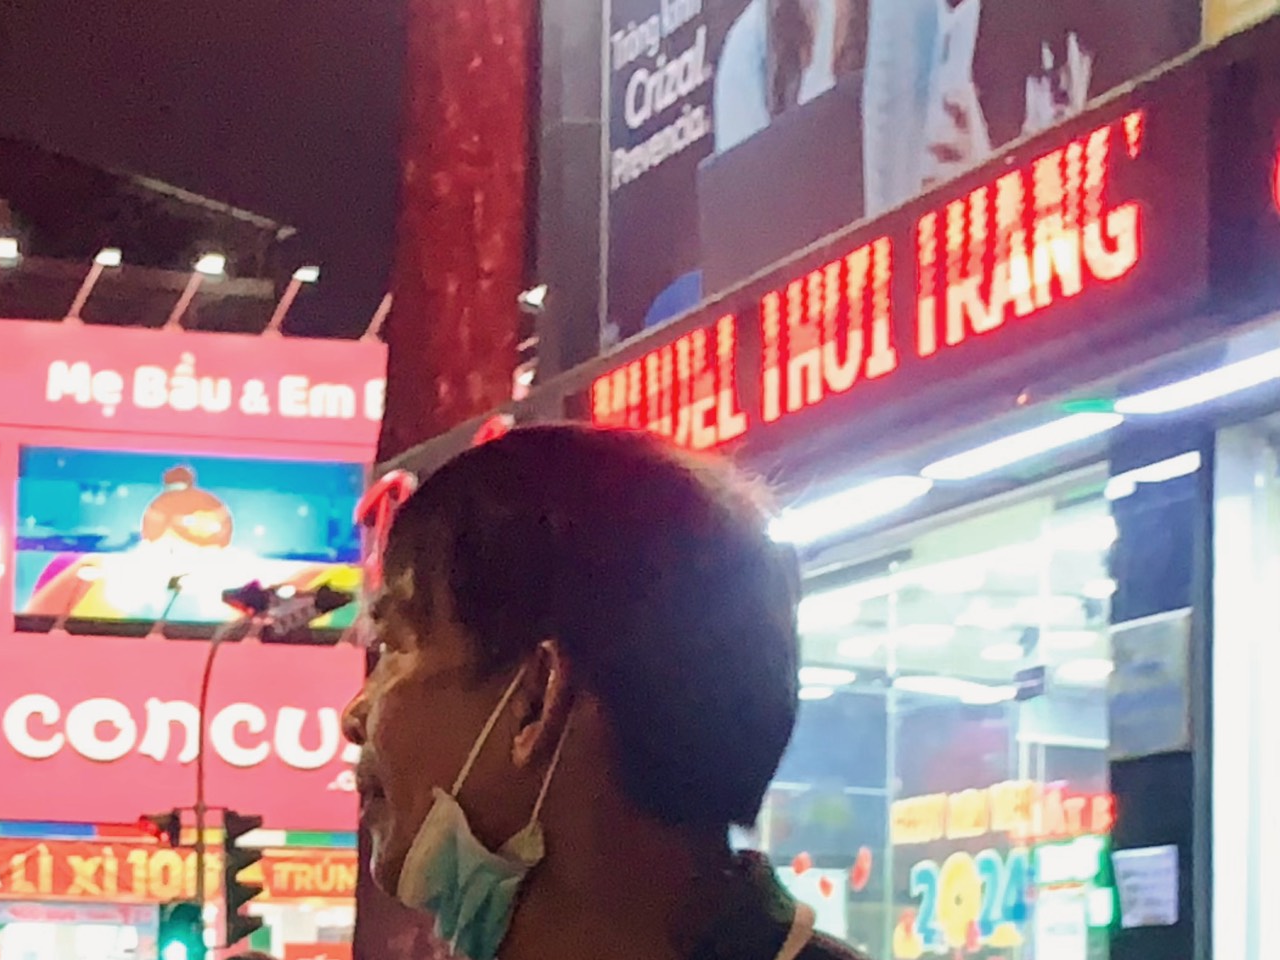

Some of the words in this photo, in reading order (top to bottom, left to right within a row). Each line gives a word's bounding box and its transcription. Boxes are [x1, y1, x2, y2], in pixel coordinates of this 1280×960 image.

[625, 24, 707, 128] Crizal
[46, 360, 124, 418] Mẹ
[239, 379, 270, 415] &
[278, 374, 356, 419] Em
[3, 693, 361, 769] concu
[272, 859, 358, 893] TRÚN
[910, 848, 1028, 950] 2024
